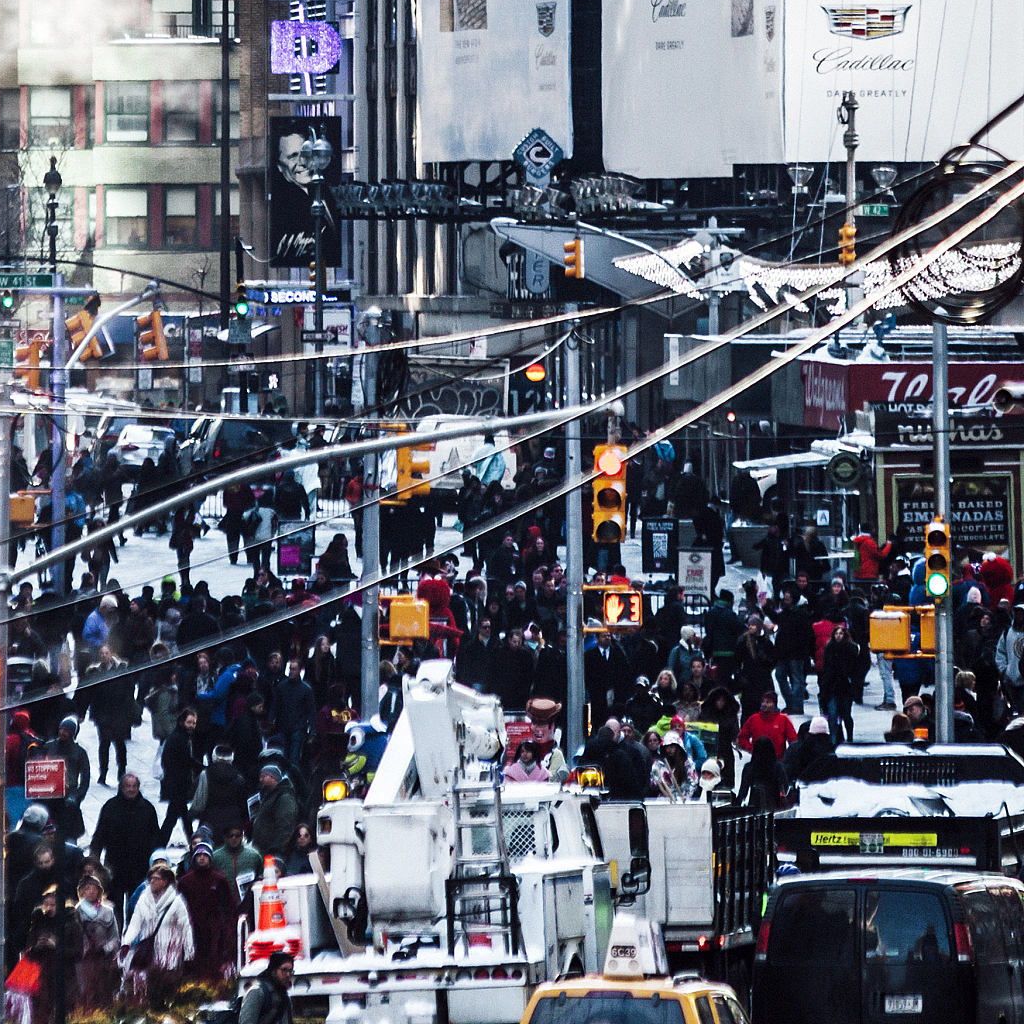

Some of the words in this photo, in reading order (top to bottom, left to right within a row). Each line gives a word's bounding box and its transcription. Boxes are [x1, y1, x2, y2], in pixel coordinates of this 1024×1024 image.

[813, 47, 914, 74] Cadillac
[860, 90, 907, 98] GREATLY
[0, 277, 9, 286] W
[12, 277, 22, 286] 41
[898, 418, 1004, 443] nuhas
[815, 835, 841, 844] Hertz
[611, 947, 636, 958] 6C39
